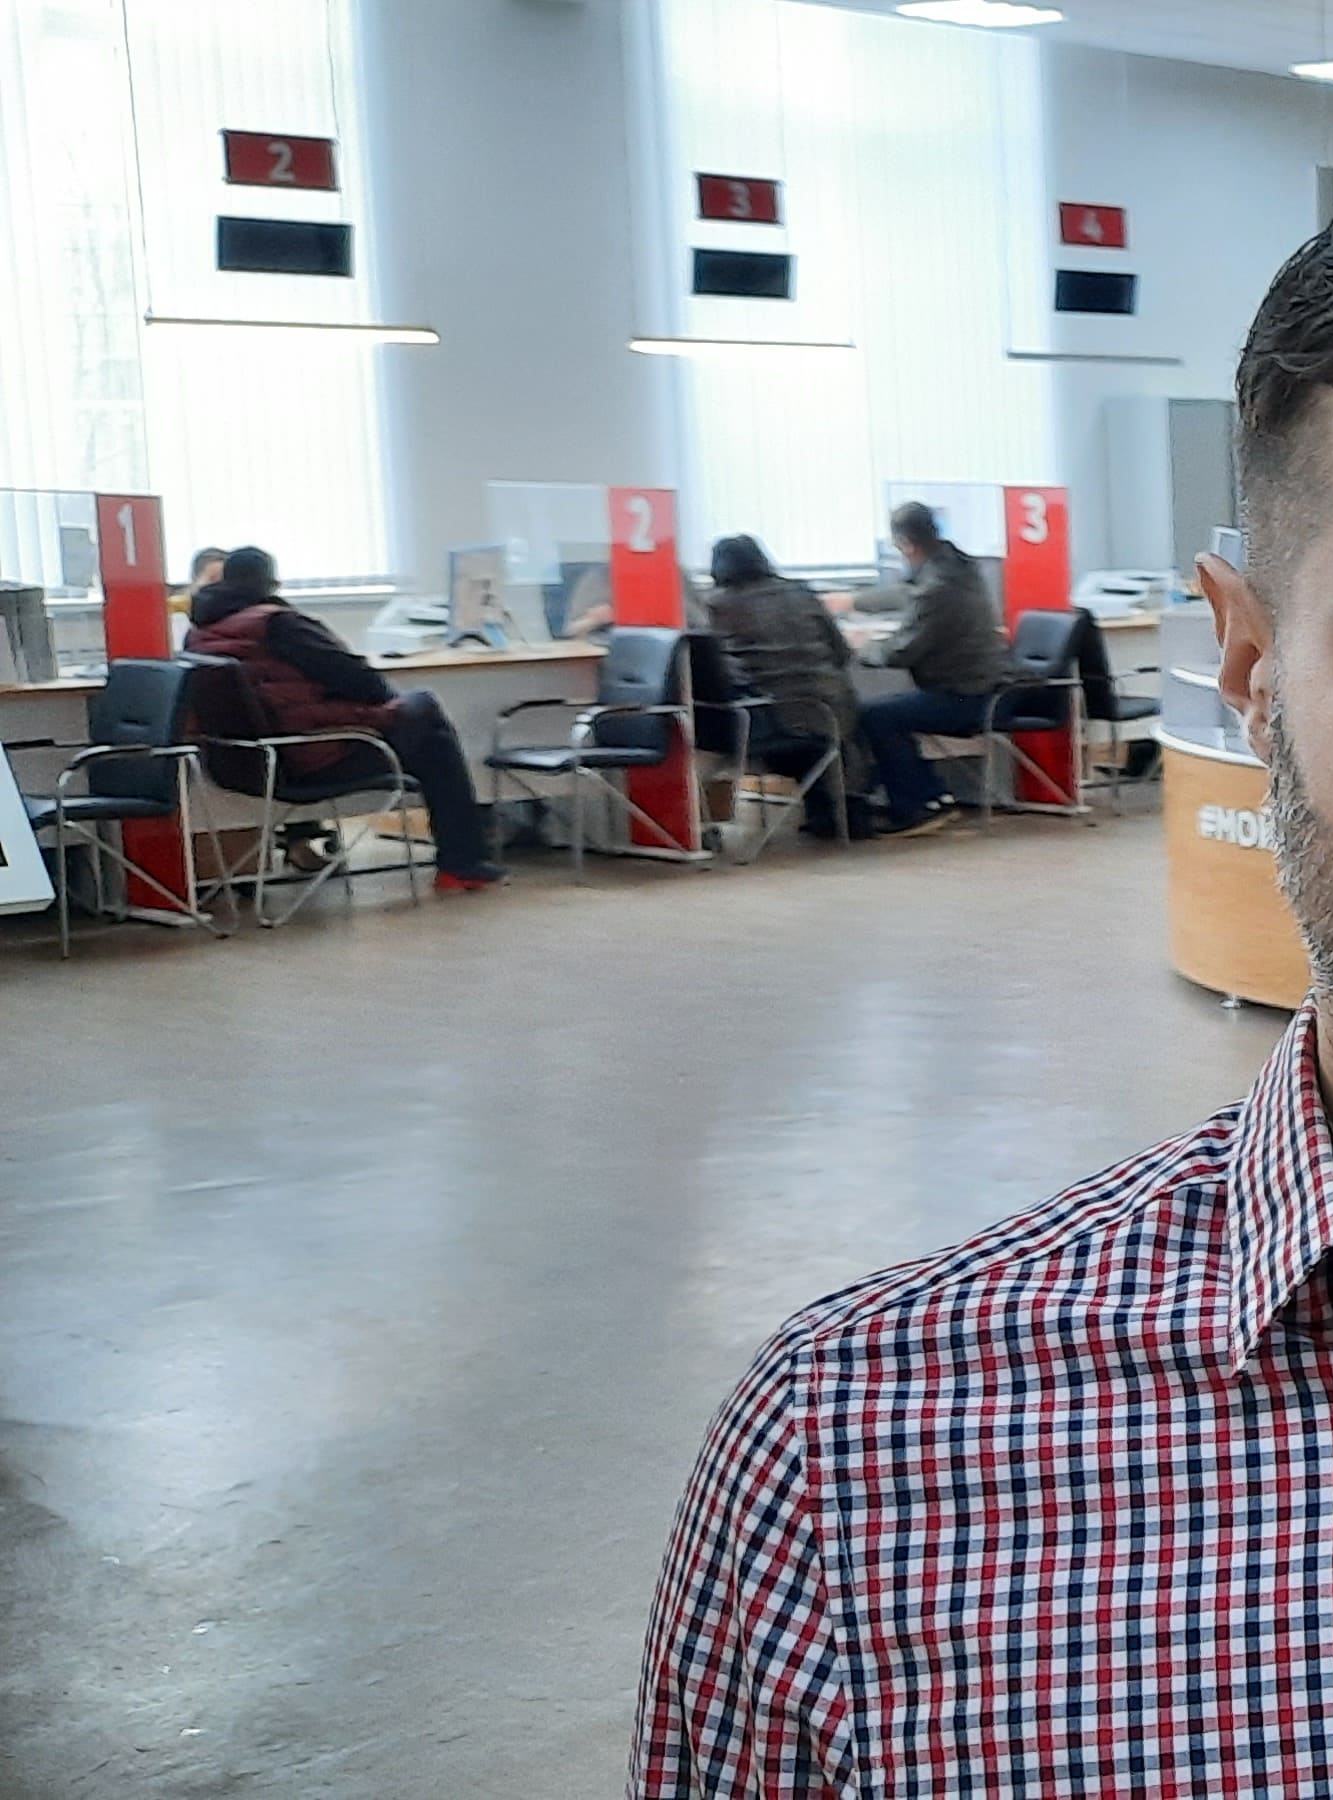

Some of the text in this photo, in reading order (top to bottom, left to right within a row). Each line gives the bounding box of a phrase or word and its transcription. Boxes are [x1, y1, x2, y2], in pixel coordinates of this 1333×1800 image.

[268, 142, 294, 183] 2
[729, 184, 751, 217] 3
[117, 504, 136, 566] 1
[627, 497, 653, 552] 2
[1019, 493, 1048, 543] 3
